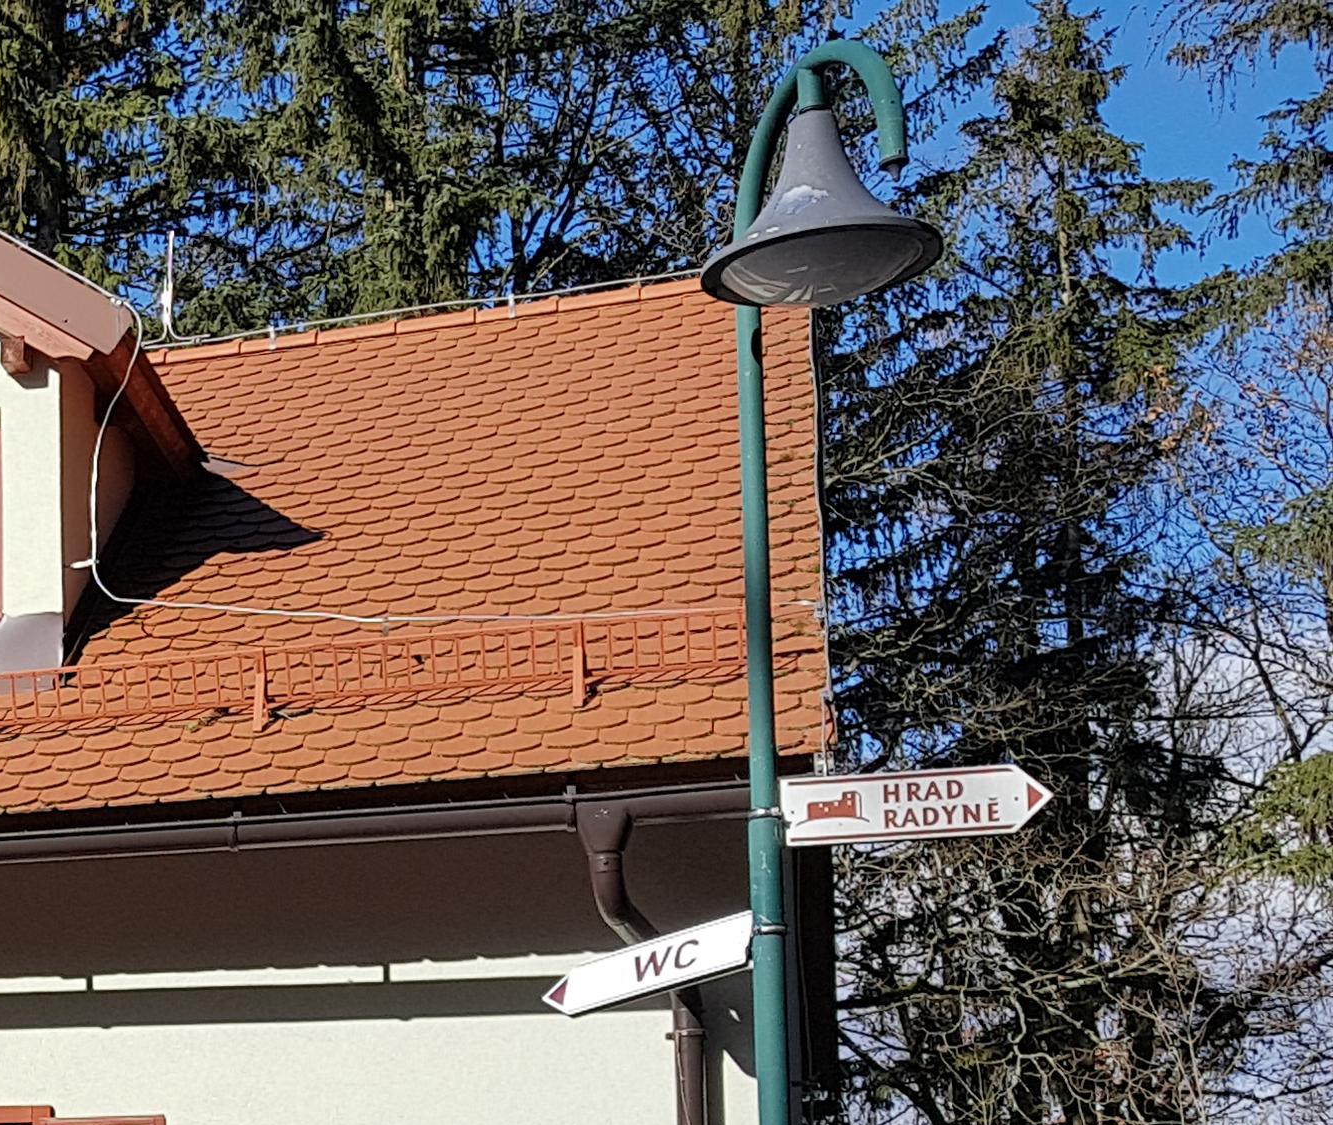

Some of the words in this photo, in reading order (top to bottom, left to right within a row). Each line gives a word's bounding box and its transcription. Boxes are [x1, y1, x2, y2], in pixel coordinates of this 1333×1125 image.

[883, 780, 964, 804] HRAD
[883, 797, 1001, 829] RADYNĚ
[634, 939, 700, 983] WC
